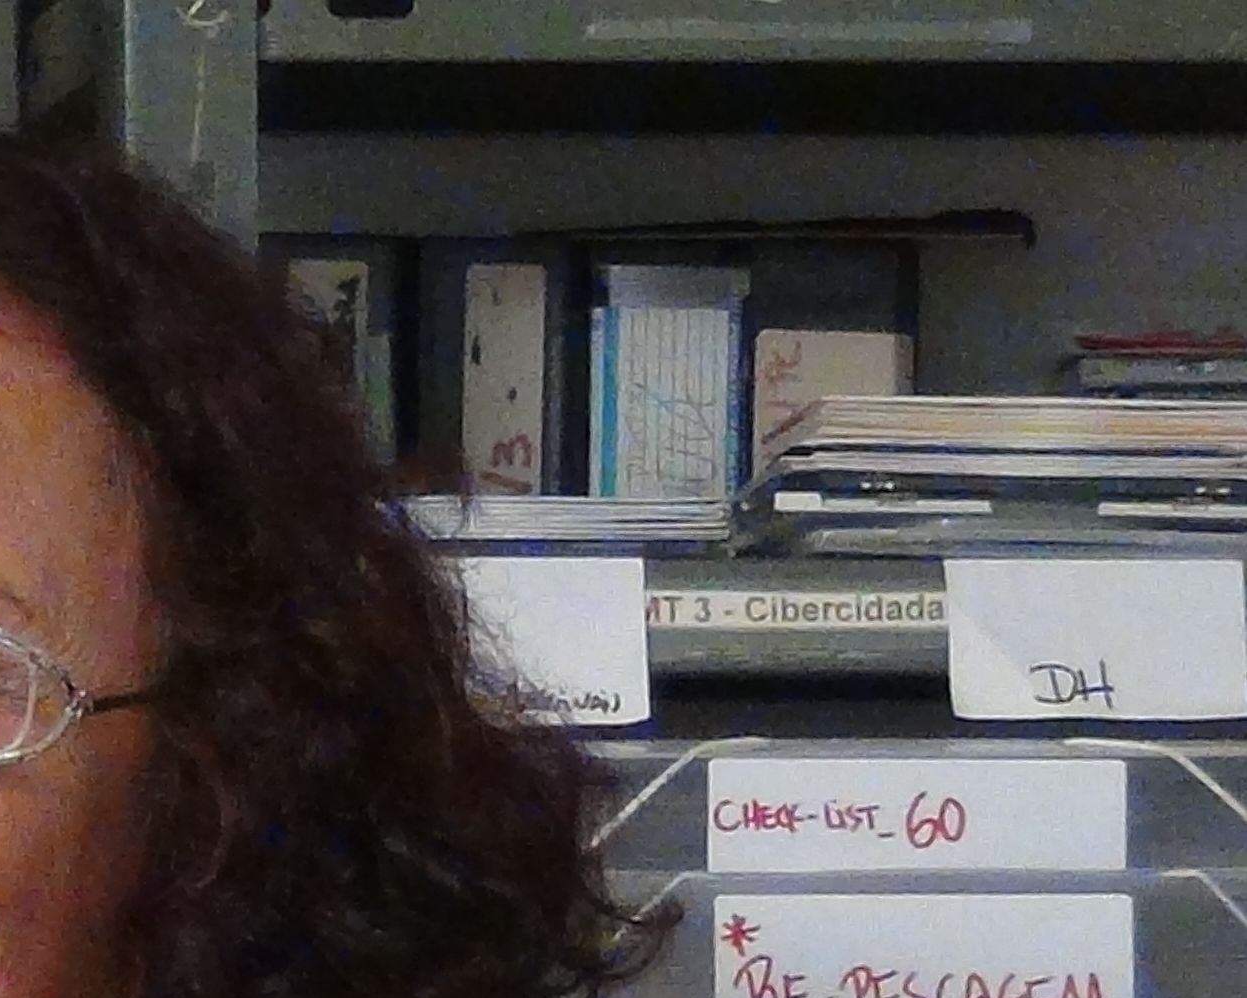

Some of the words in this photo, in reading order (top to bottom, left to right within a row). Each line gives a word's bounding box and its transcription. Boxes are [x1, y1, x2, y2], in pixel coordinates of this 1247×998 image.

[694, 597, 712, 623] 3
[744, 595, 945, 622] Cibercidada
[1028, 658, 1115, 711] DH
[906, 791, 967, 849] 60
